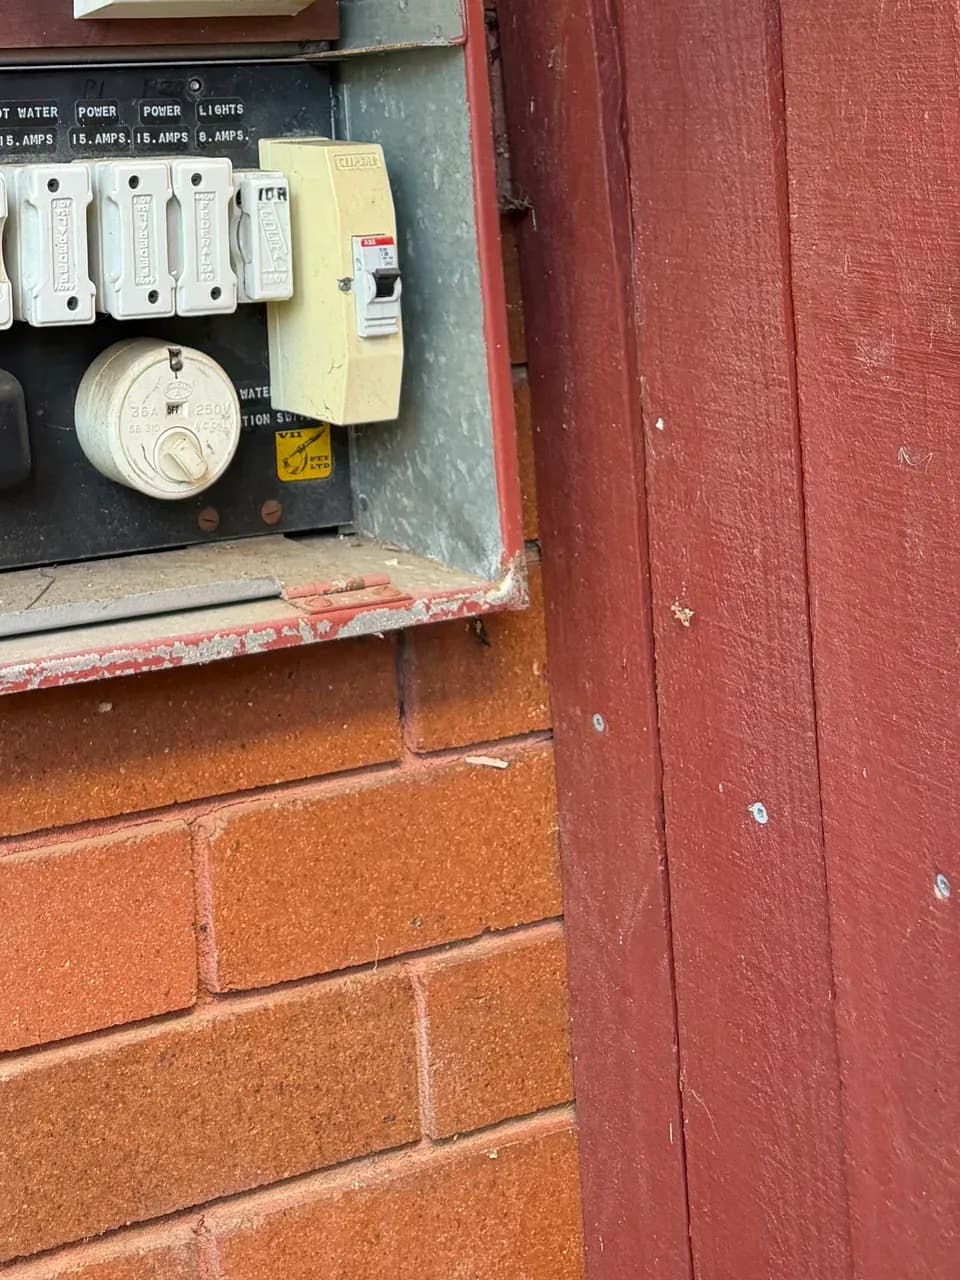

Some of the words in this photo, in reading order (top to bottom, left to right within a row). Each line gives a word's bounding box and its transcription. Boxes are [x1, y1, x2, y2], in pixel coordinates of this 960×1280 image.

[18, 106, 59, 119] WATER
[78, 106, 117, 117] POWER
[143, 105, 182, 116] POWER
[199, 104, 244, 116] LIGHTS
[240, 386, 270, 400] WATE
[130, 406, 159, 418] 36A
[196, 401, 232, 417] 250V
